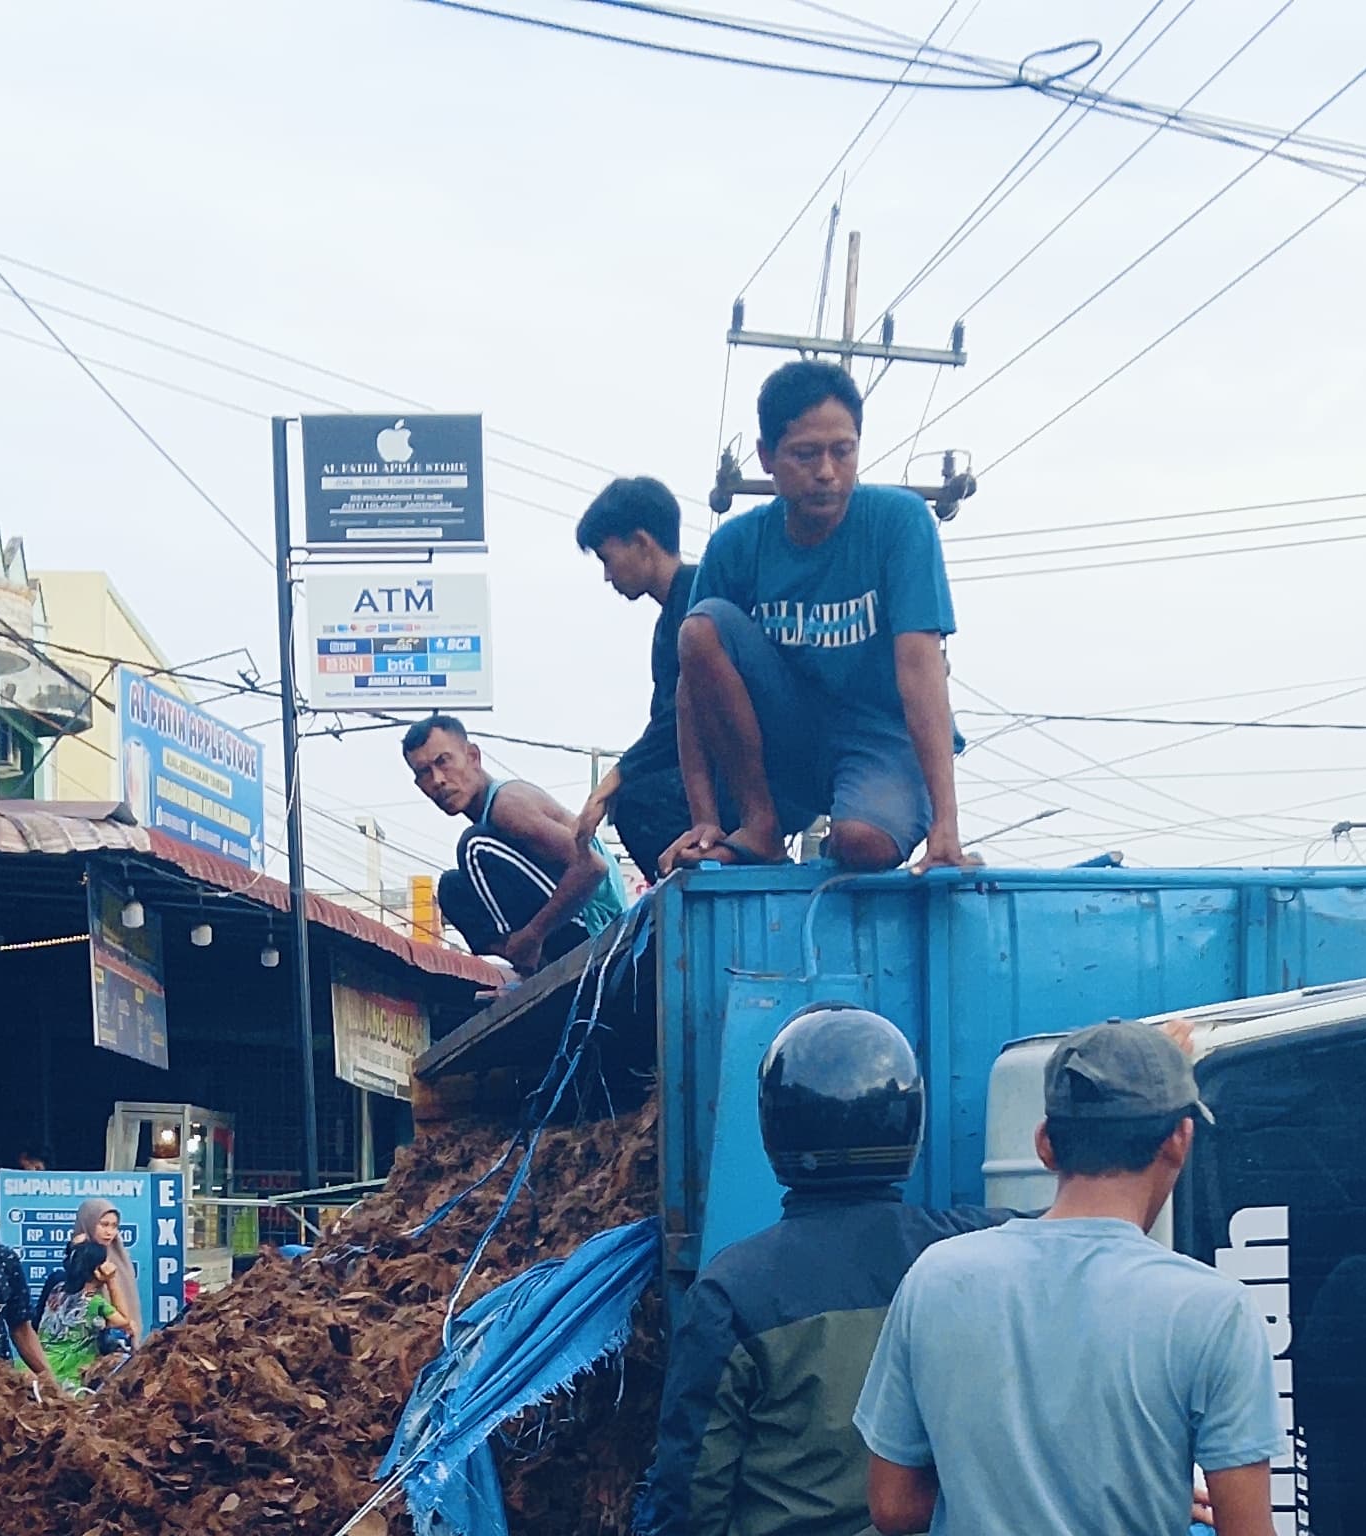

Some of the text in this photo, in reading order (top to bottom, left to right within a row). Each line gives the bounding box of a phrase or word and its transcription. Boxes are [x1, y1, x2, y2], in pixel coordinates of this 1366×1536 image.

[353, 586, 434, 614] ATM
[446, 637, 472, 652] BCA
[129, 679, 258, 783] AL FATIH APPLE STORE
[4, 1178, 144, 1197] SIMPANG LAUNDRY
